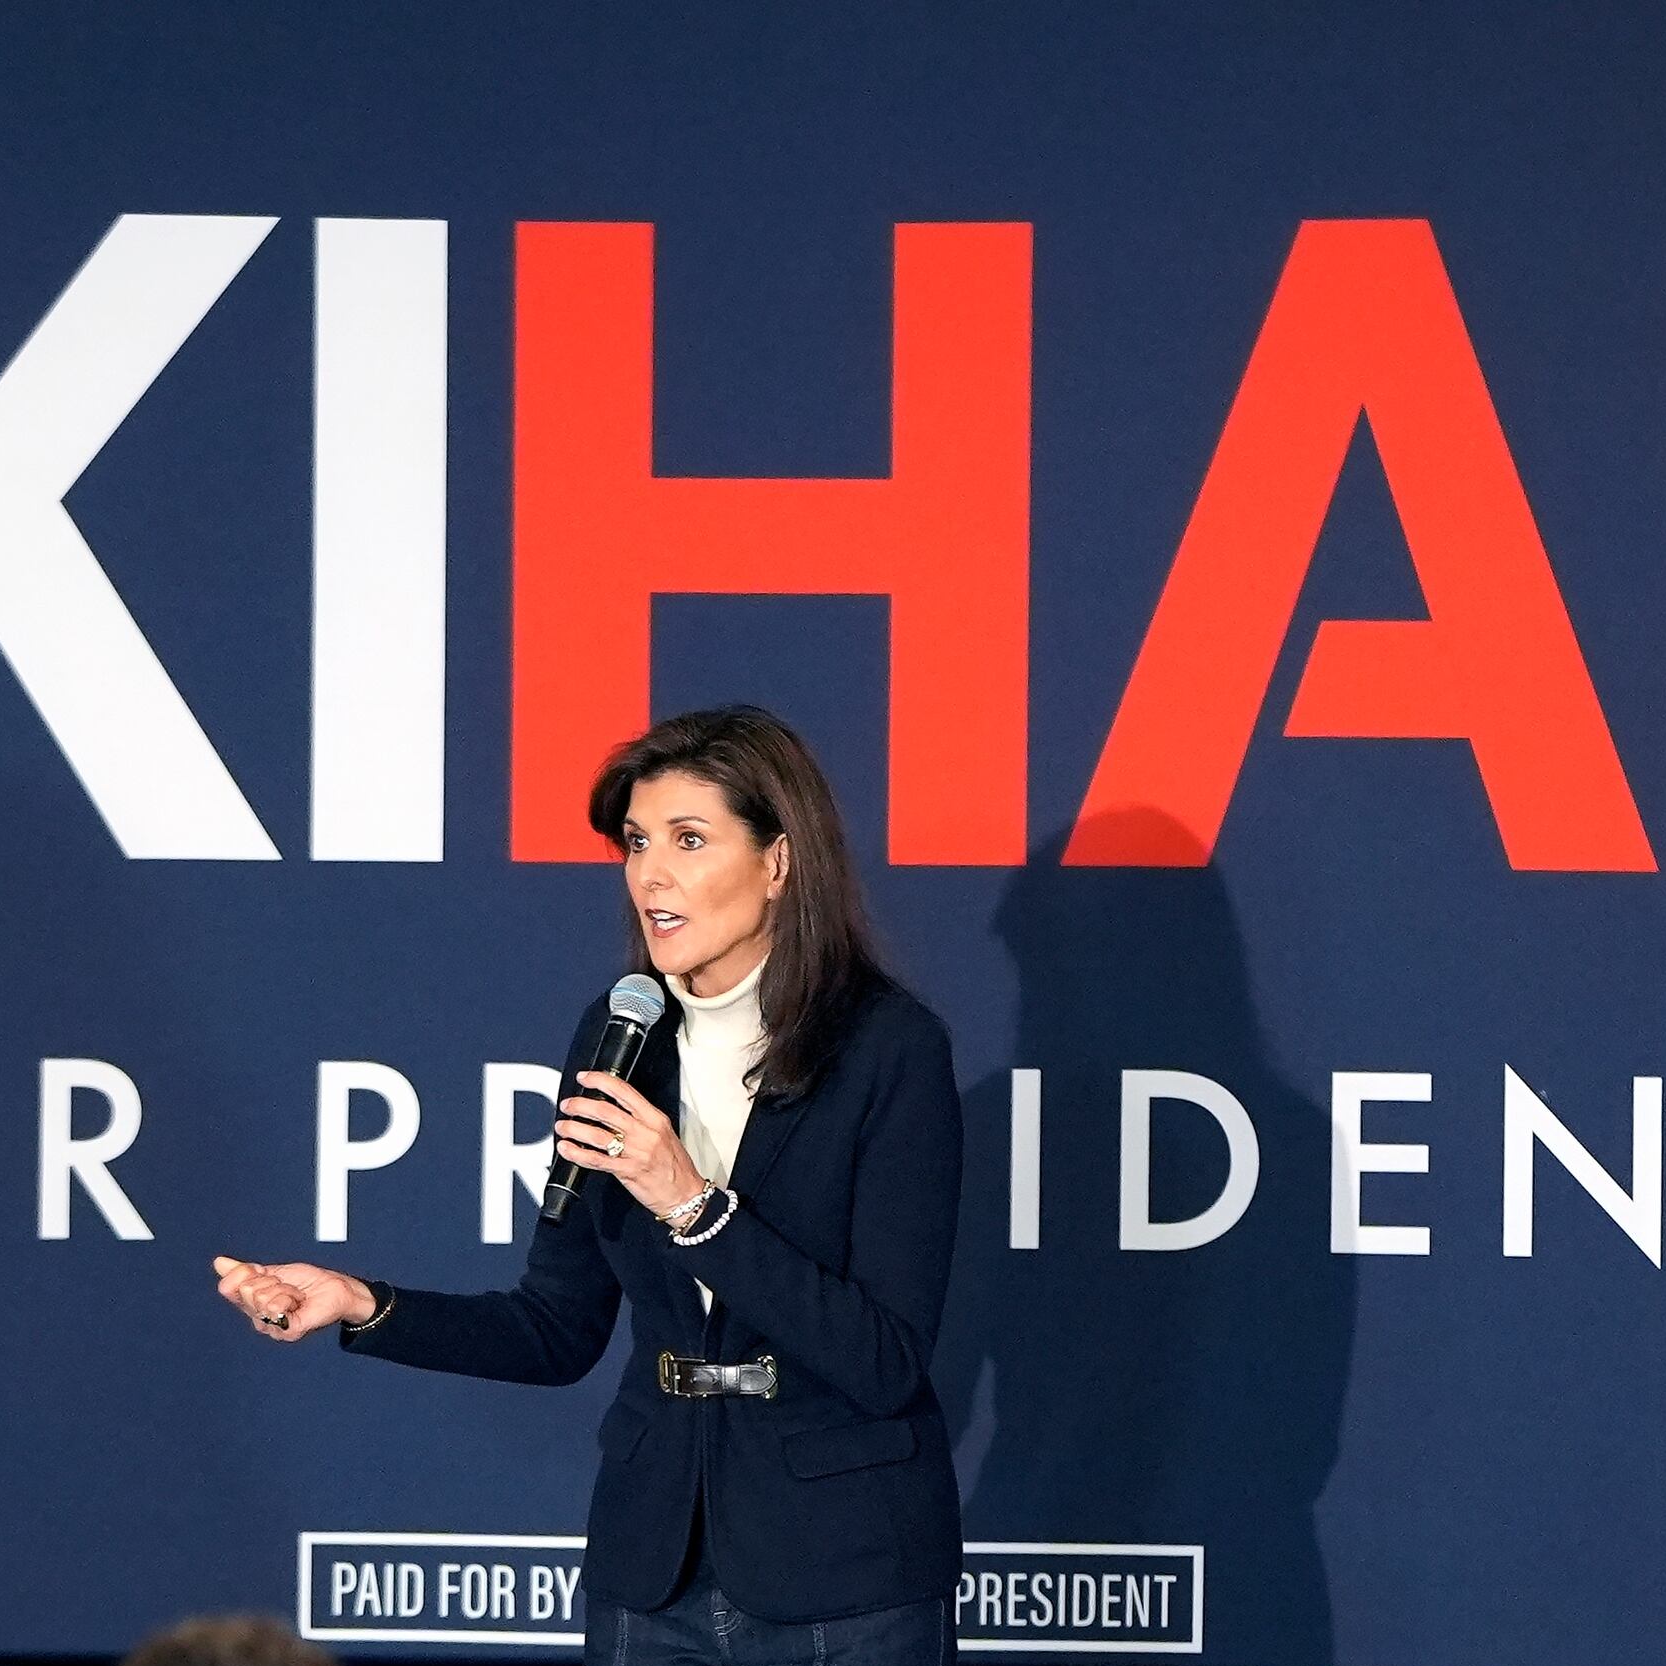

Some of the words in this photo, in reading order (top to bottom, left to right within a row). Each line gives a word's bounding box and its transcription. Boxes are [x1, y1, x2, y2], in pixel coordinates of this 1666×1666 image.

[330, 1560, 426, 1618] PAID
[437, 1562, 517, 1621] FOR
[528, 1564, 583, 1622] BY
[954, 1570, 1179, 1630] PRESIDENT
